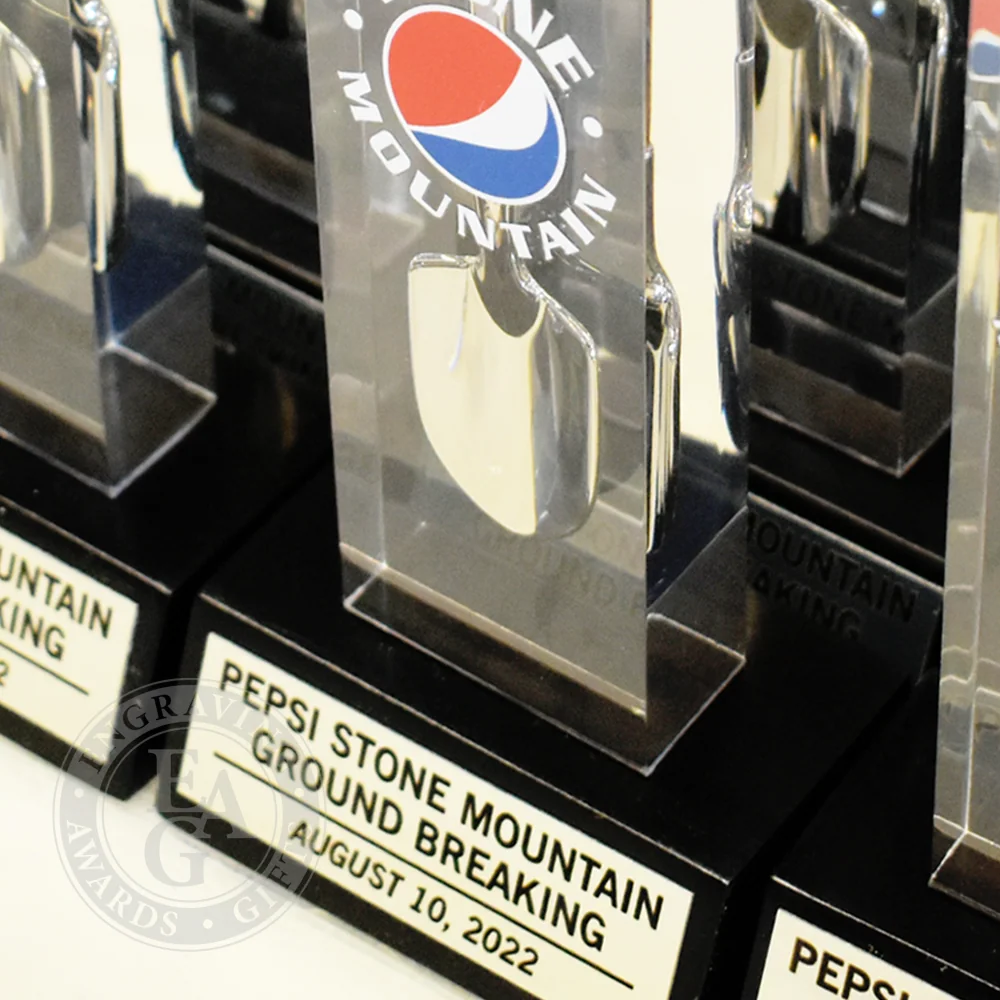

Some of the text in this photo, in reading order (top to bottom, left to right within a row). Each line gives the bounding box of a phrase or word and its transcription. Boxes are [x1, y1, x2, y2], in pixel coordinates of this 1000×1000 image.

[337, 70, 617, 260] MOUNTAIN
[747, 512, 916, 622] OUNTAIN
[219, 659, 664, 931] PEPSI STONE MOUNTAIN
[251, 728, 607, 952] GROUND BREAKING
[288, 820, 540, 977] AUGUST 10, 2022
[789, 936, 910, 1000] PEPS
